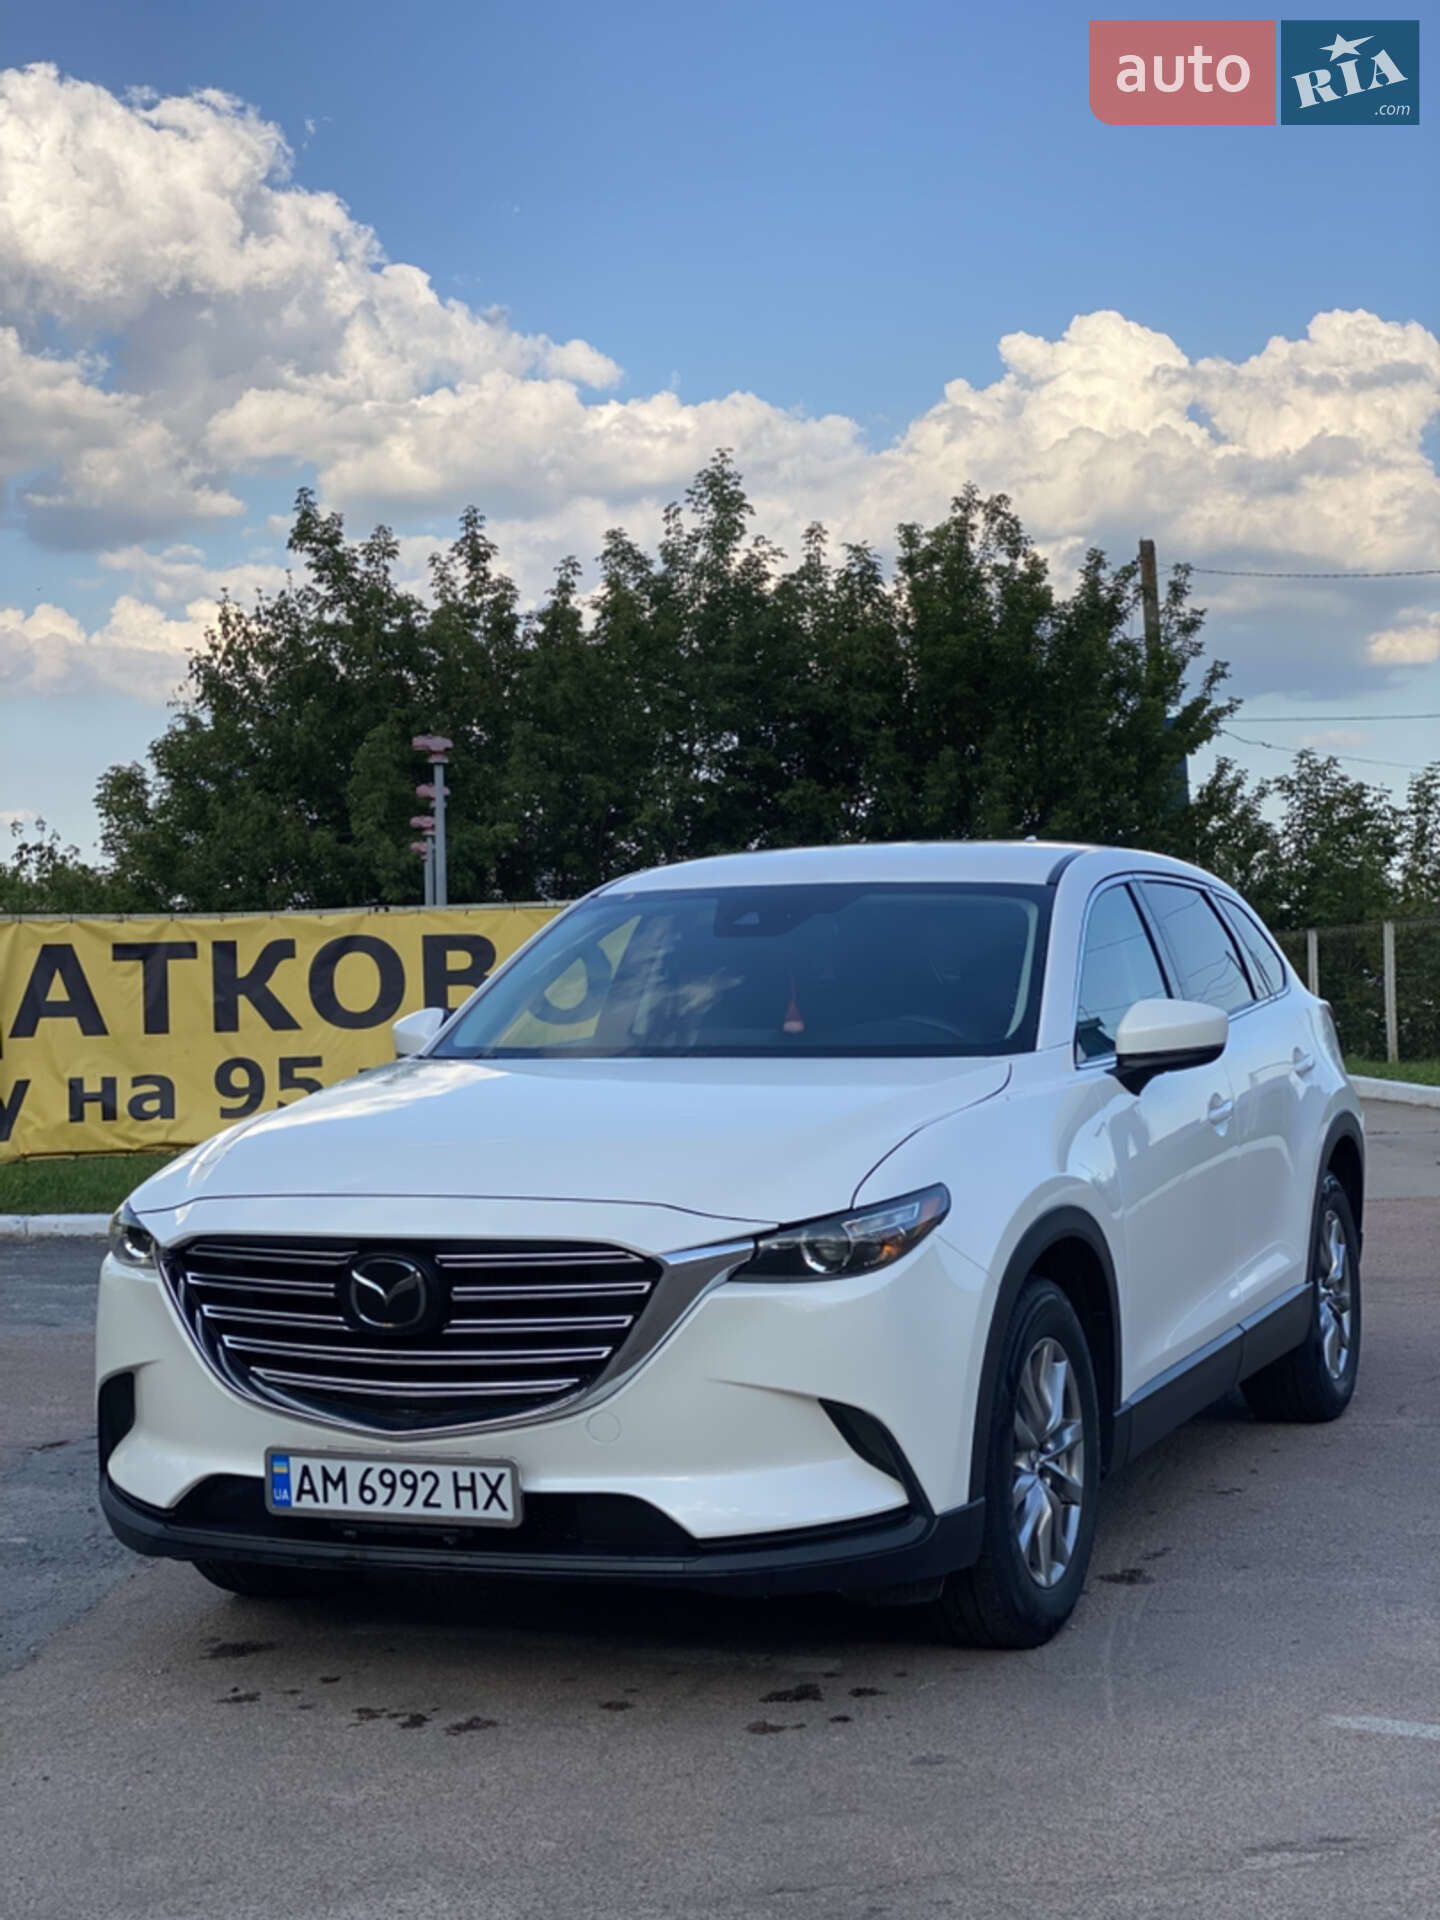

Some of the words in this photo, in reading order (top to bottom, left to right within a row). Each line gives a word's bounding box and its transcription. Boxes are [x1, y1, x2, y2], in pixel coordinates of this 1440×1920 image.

[68, 1073, 176, 1123] на
[273, 1488, 290, 1501] UA
[296, 1464, 349, 1505] AM
[358, 1466, 443, 1509] 6992
[452, 1470, 509, 1512] HX
